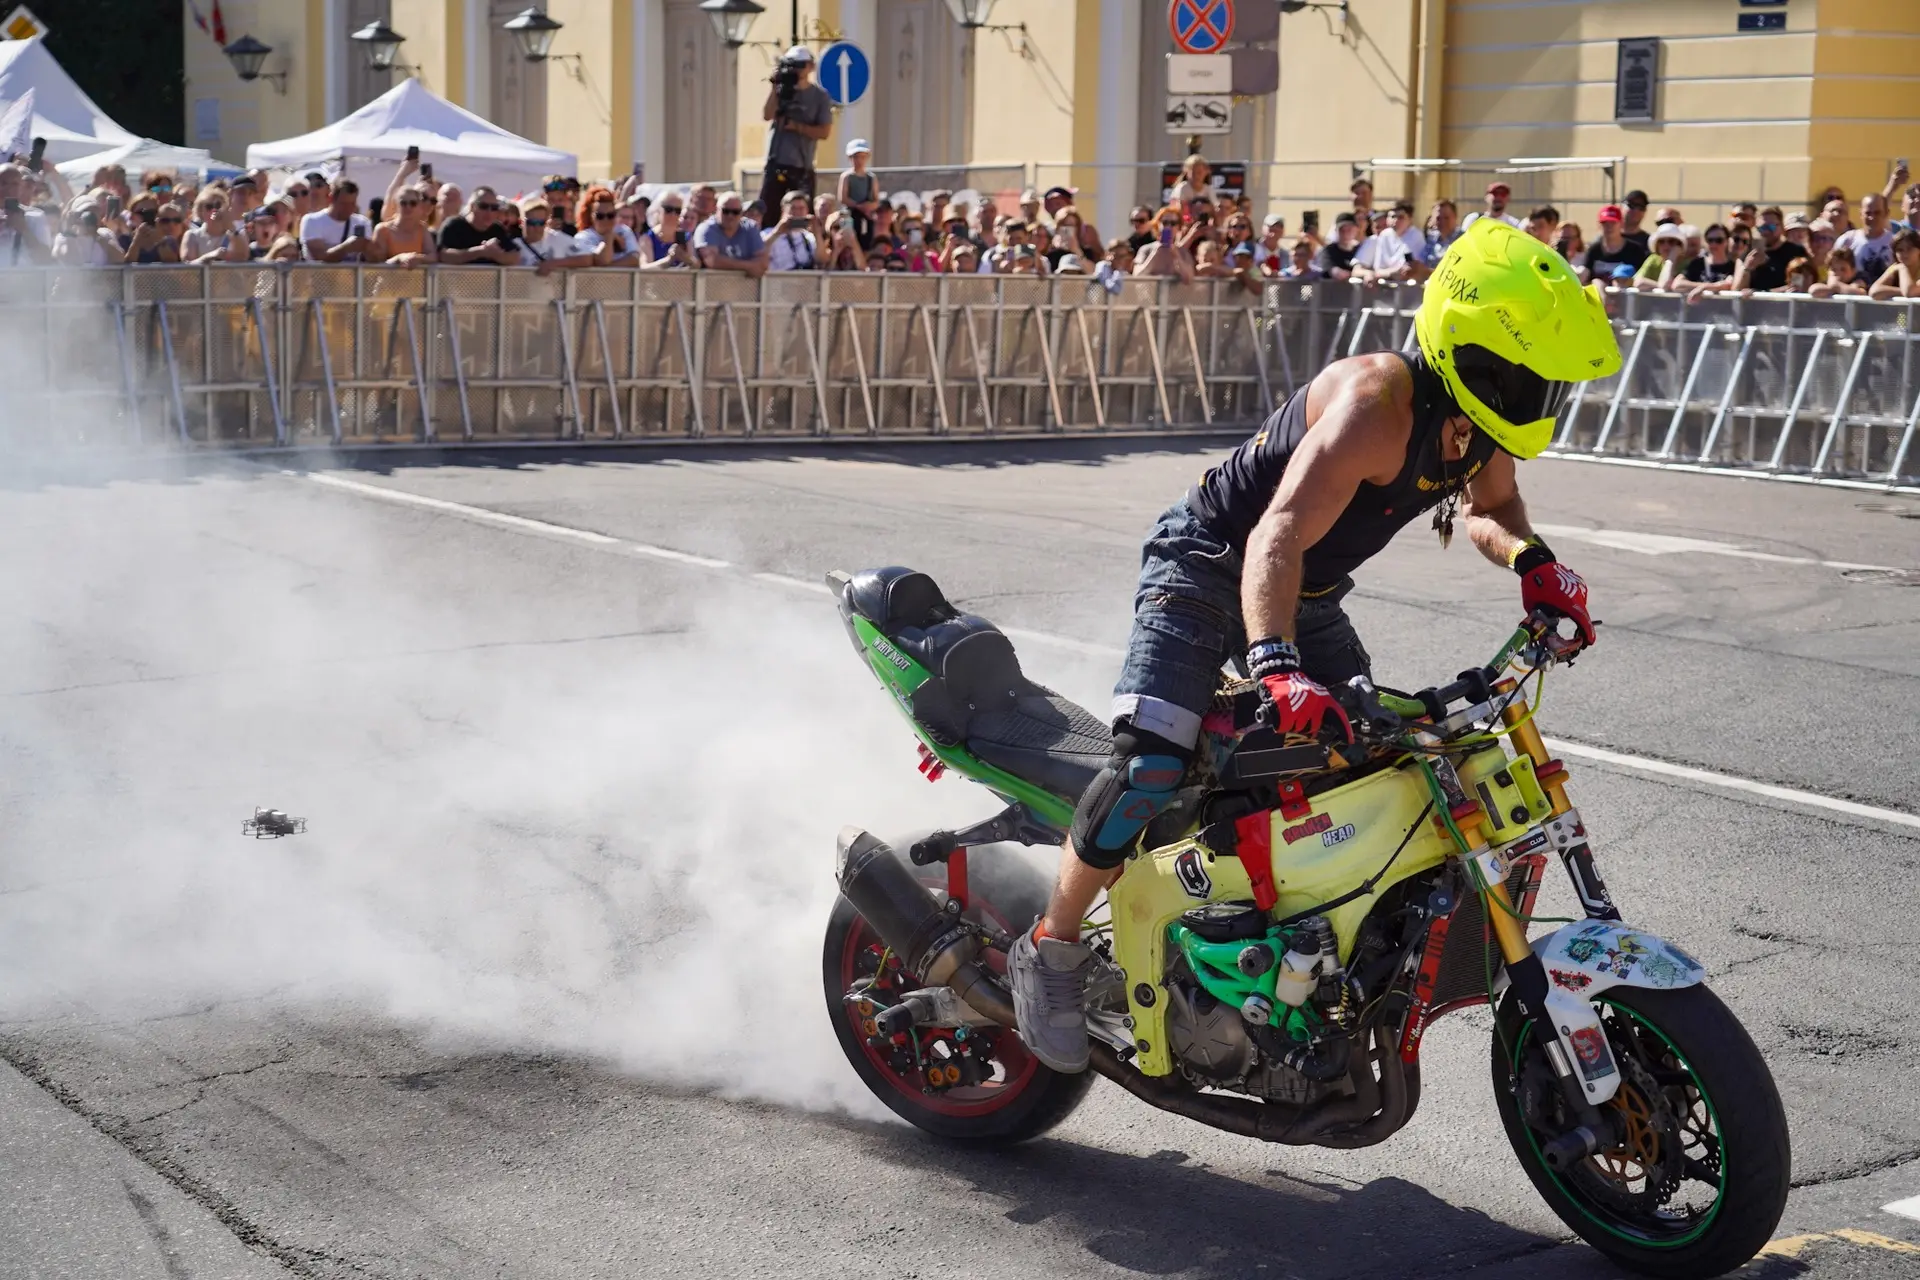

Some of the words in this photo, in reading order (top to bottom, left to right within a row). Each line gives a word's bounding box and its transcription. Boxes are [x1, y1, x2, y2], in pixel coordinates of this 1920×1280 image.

[872, 636, 894, 657] WHY
[888, 650, 912, 671] NOT
[1322, 823, 1356, 848] HEAD
[1529, 836, 1545, 847] CLUB
